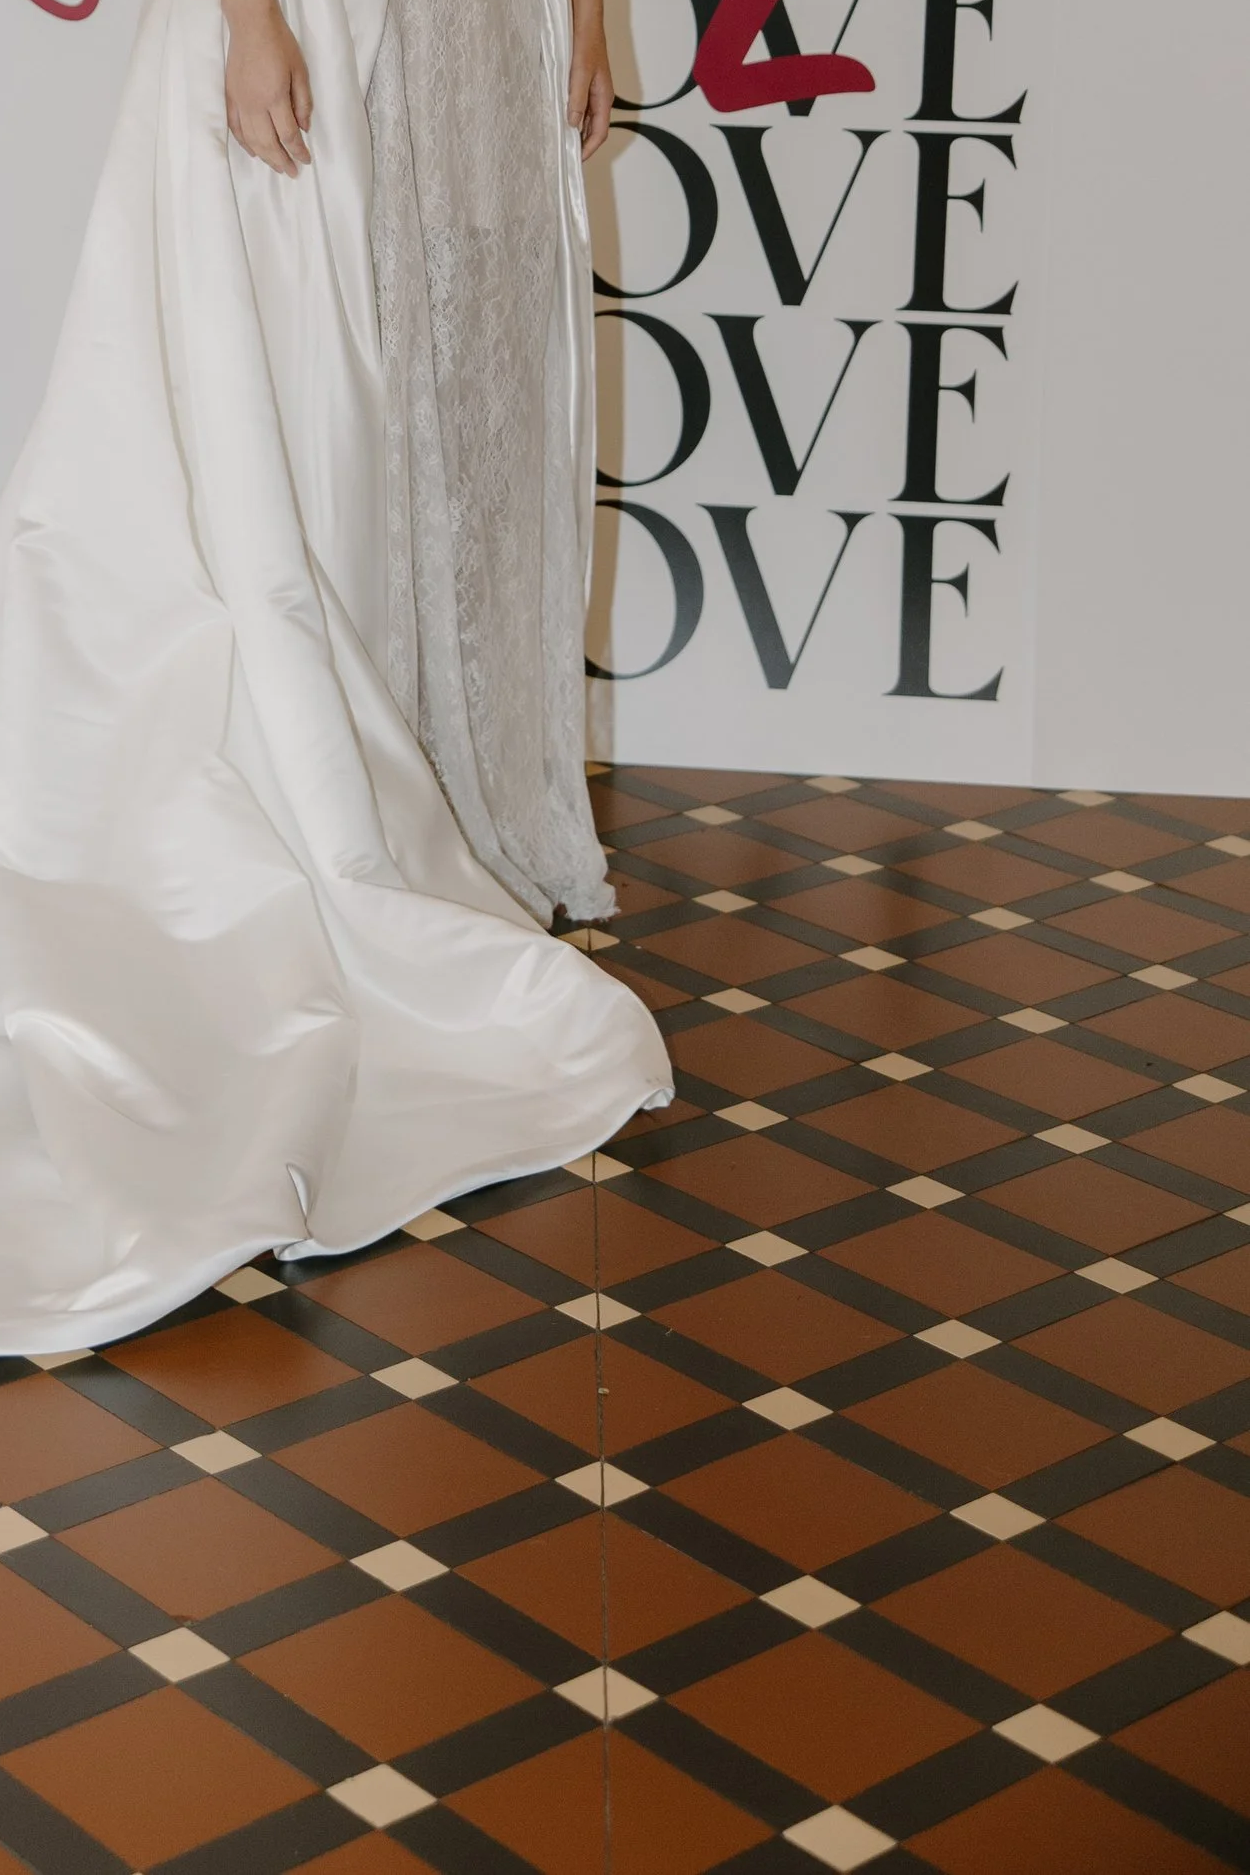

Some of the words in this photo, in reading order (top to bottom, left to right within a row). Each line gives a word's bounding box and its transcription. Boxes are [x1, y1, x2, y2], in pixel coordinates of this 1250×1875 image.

[592, 120, 1019, 316] OVE
[594, 309, 1011, 507] OVE
[583, 499, 1005, 702] OVE
